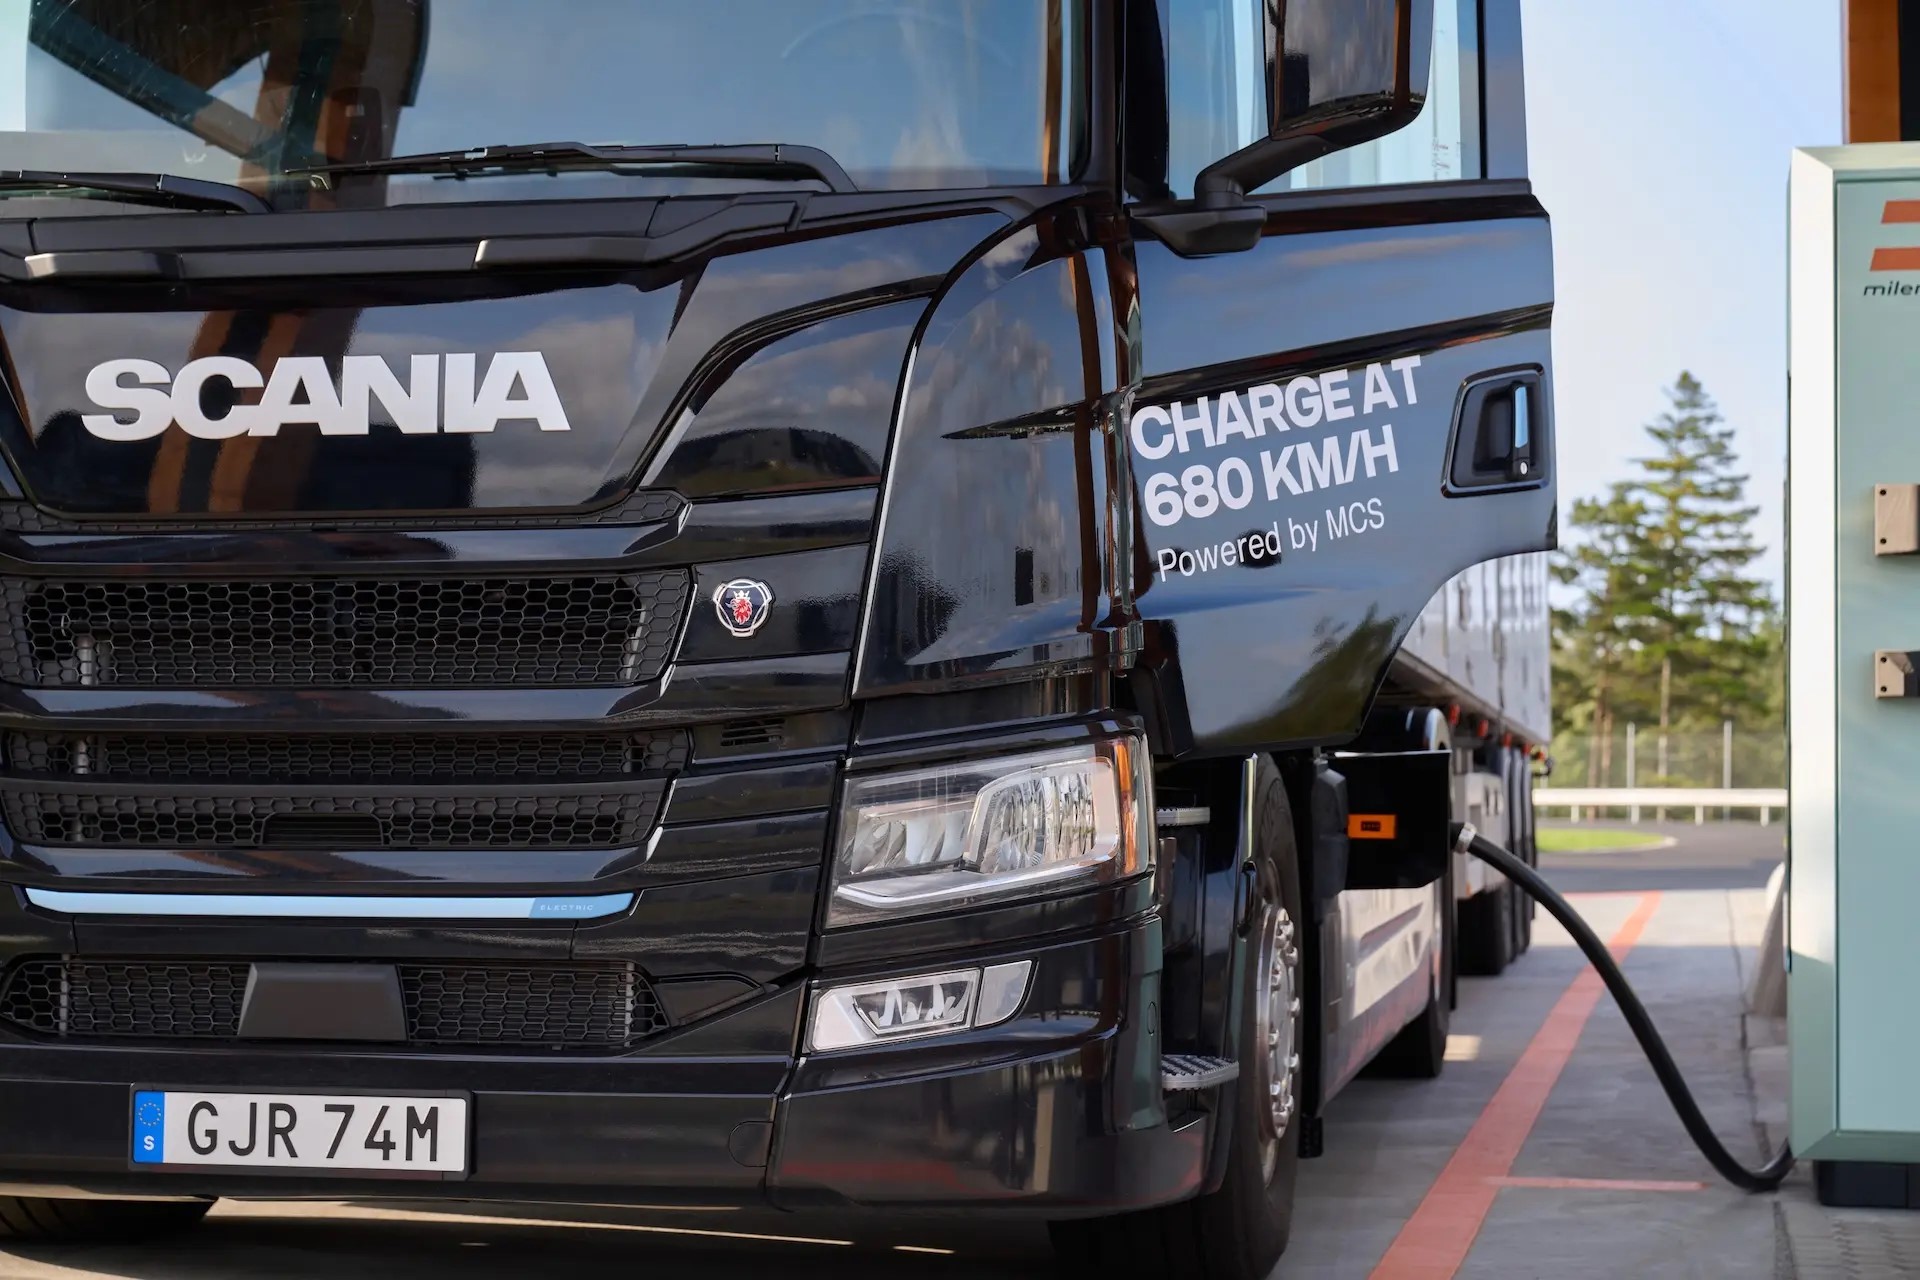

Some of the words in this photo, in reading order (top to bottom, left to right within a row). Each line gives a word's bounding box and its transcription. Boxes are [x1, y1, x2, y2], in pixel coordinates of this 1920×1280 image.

[81, 351, 571, 441] SCANIA
[1130, 368, 1355, 460] CHARGE
[1363, 354, 1422, 415] AT
[1144, 457, 1253, 527] 680
[1261, 424, 1400, 501] KM/H
[1157, 521, 1282, 582] Powered
[1288, 517, 1319, 552] by
[1326, 498, 1385, 540] MCS
[143, 1135, 155, 1151] S
[187, 1100, 299, 1158] GJR
[324, 1103, 439, 1162] 74M
